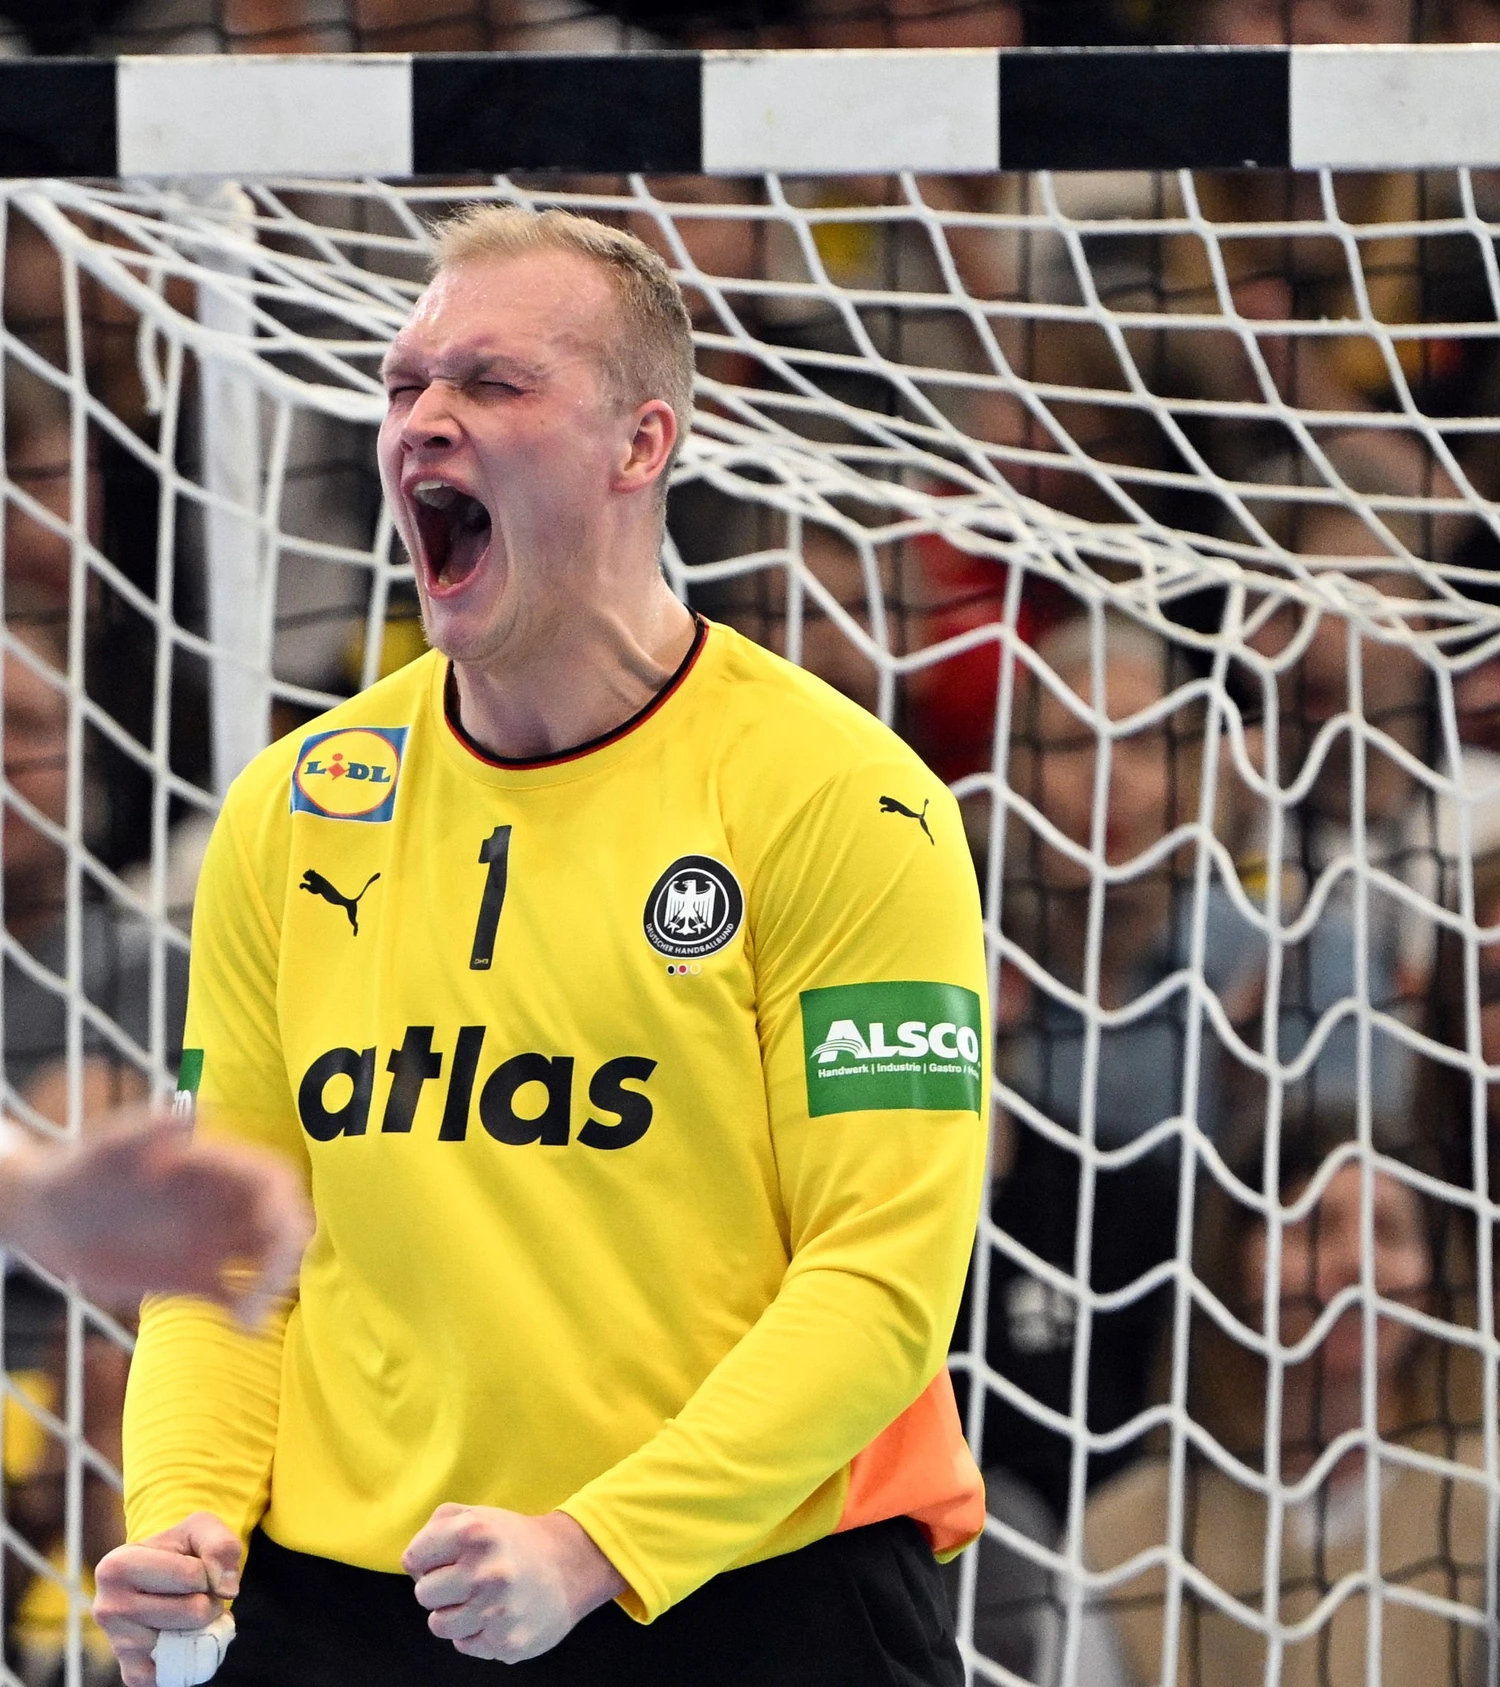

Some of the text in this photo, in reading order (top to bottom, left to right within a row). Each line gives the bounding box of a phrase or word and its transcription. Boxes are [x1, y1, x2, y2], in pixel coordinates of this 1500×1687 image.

[469, 824, 513, 970] 1
[645, 922, 735, 955] DEUTSCHER HANDBALLBUND
[811, 1019, 979, 1064] ALSCO
[298, 1025, 659, 1151] atlas
[817, 1063, 869, 1079] Handwerk
[876, 1062, 922, 1074] Industrie
[928, 1063, 962, 1074] Gastro
